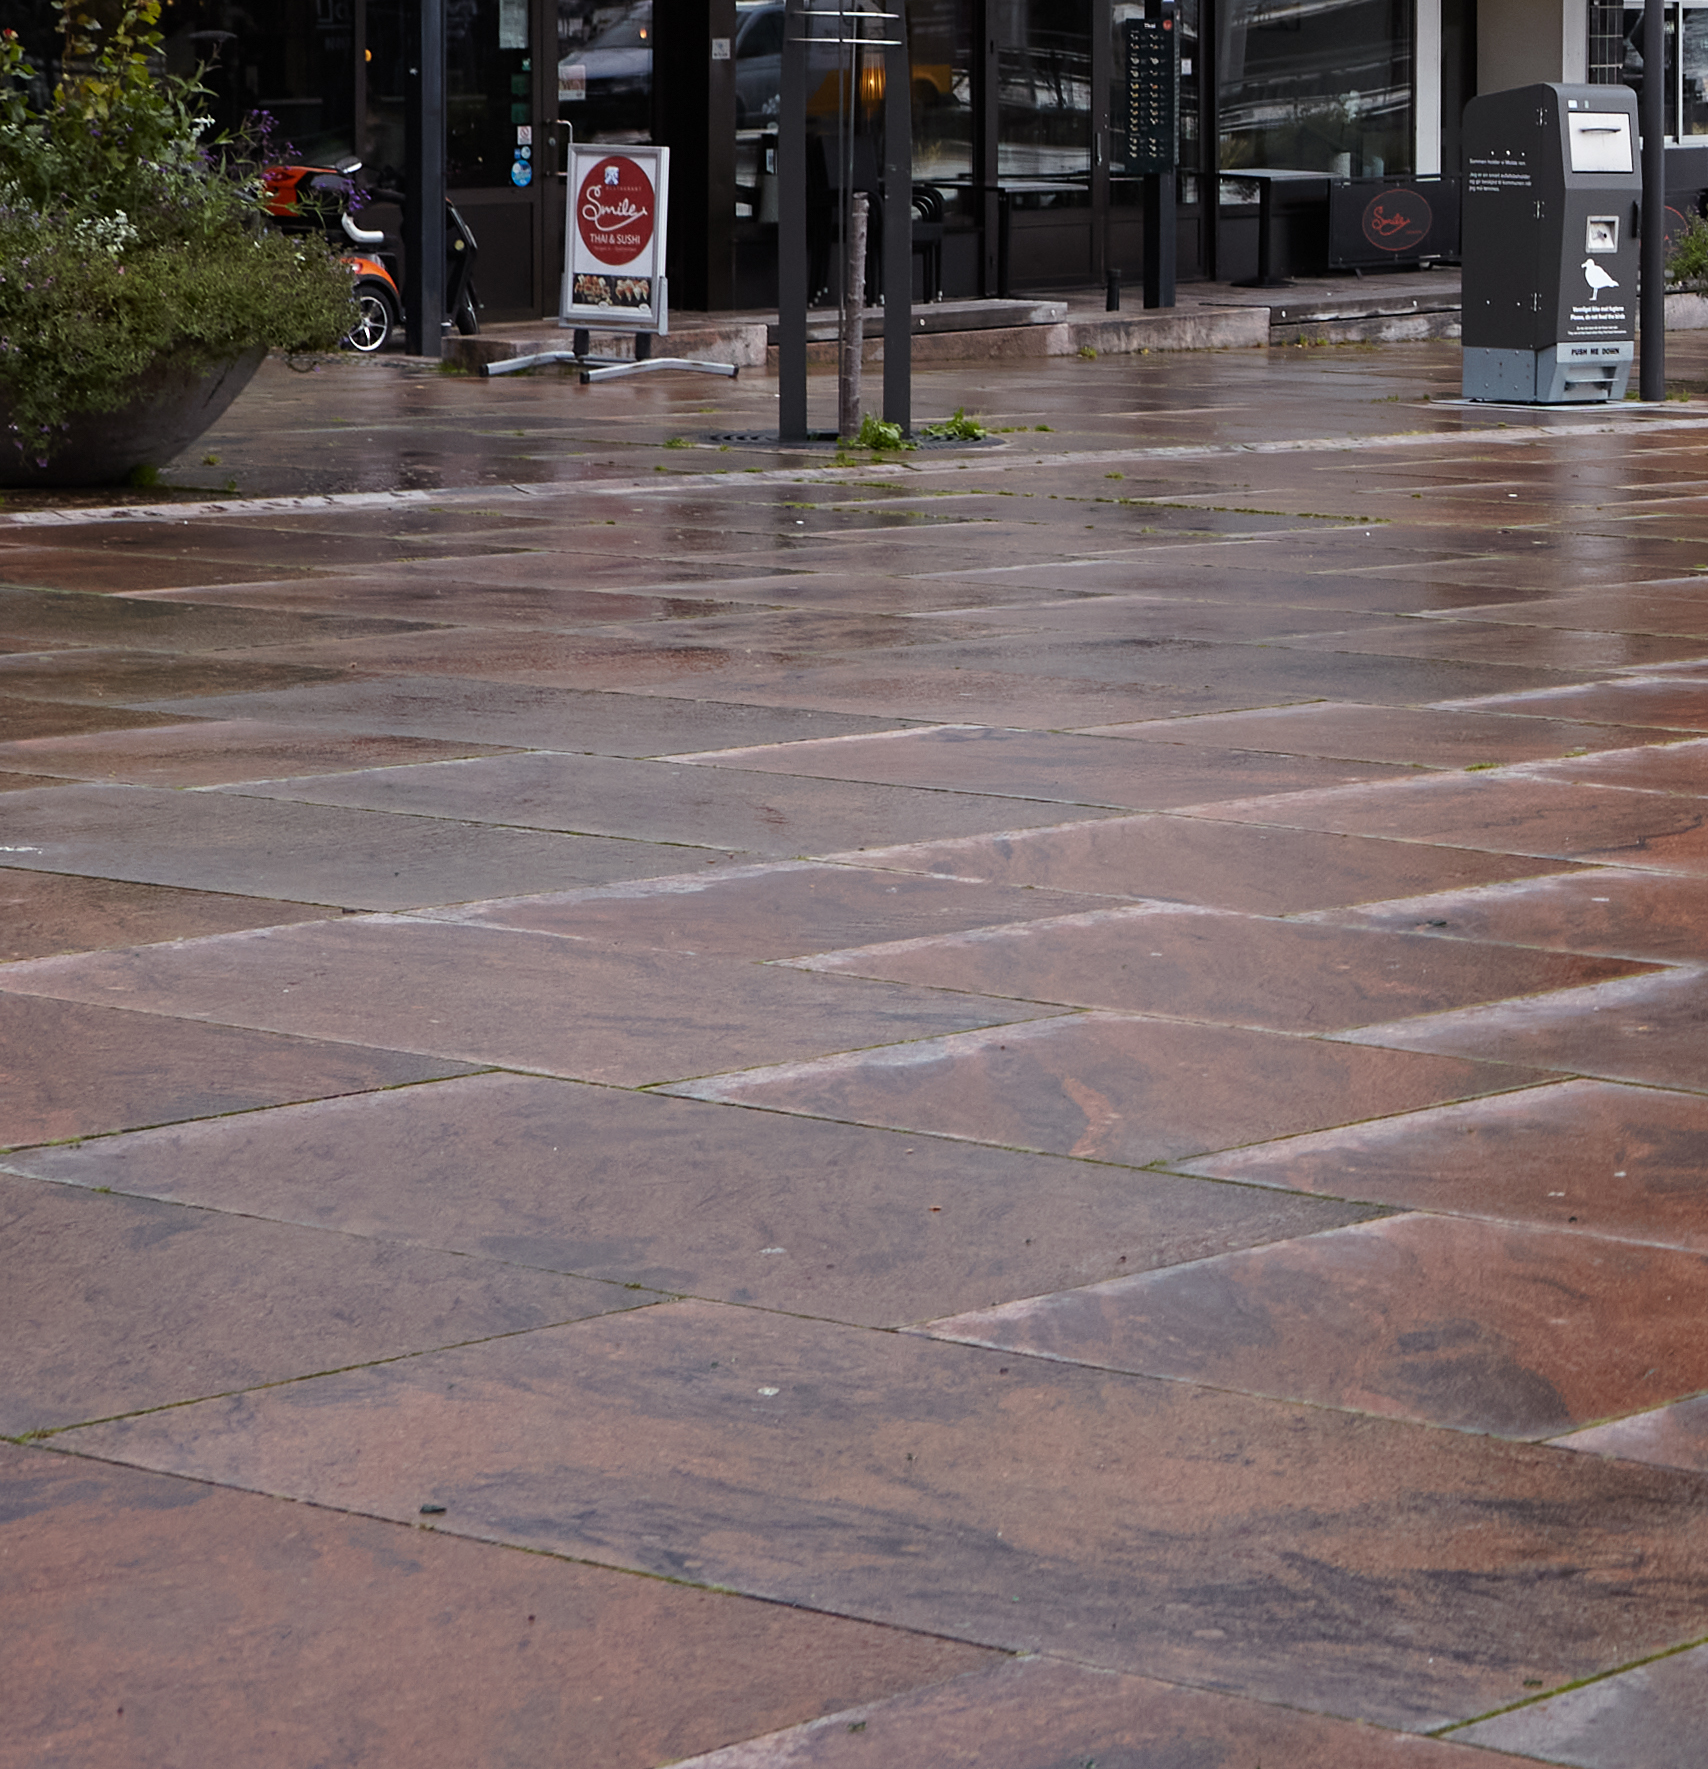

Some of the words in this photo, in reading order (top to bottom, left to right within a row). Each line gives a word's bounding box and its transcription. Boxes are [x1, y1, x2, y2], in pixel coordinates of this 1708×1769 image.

[582, 185, 648, 231] Smile
[590, 233, 608, 244] THAI
[609, 234, 615, 244] &
[616, 234, 641, 244] SUSHI
